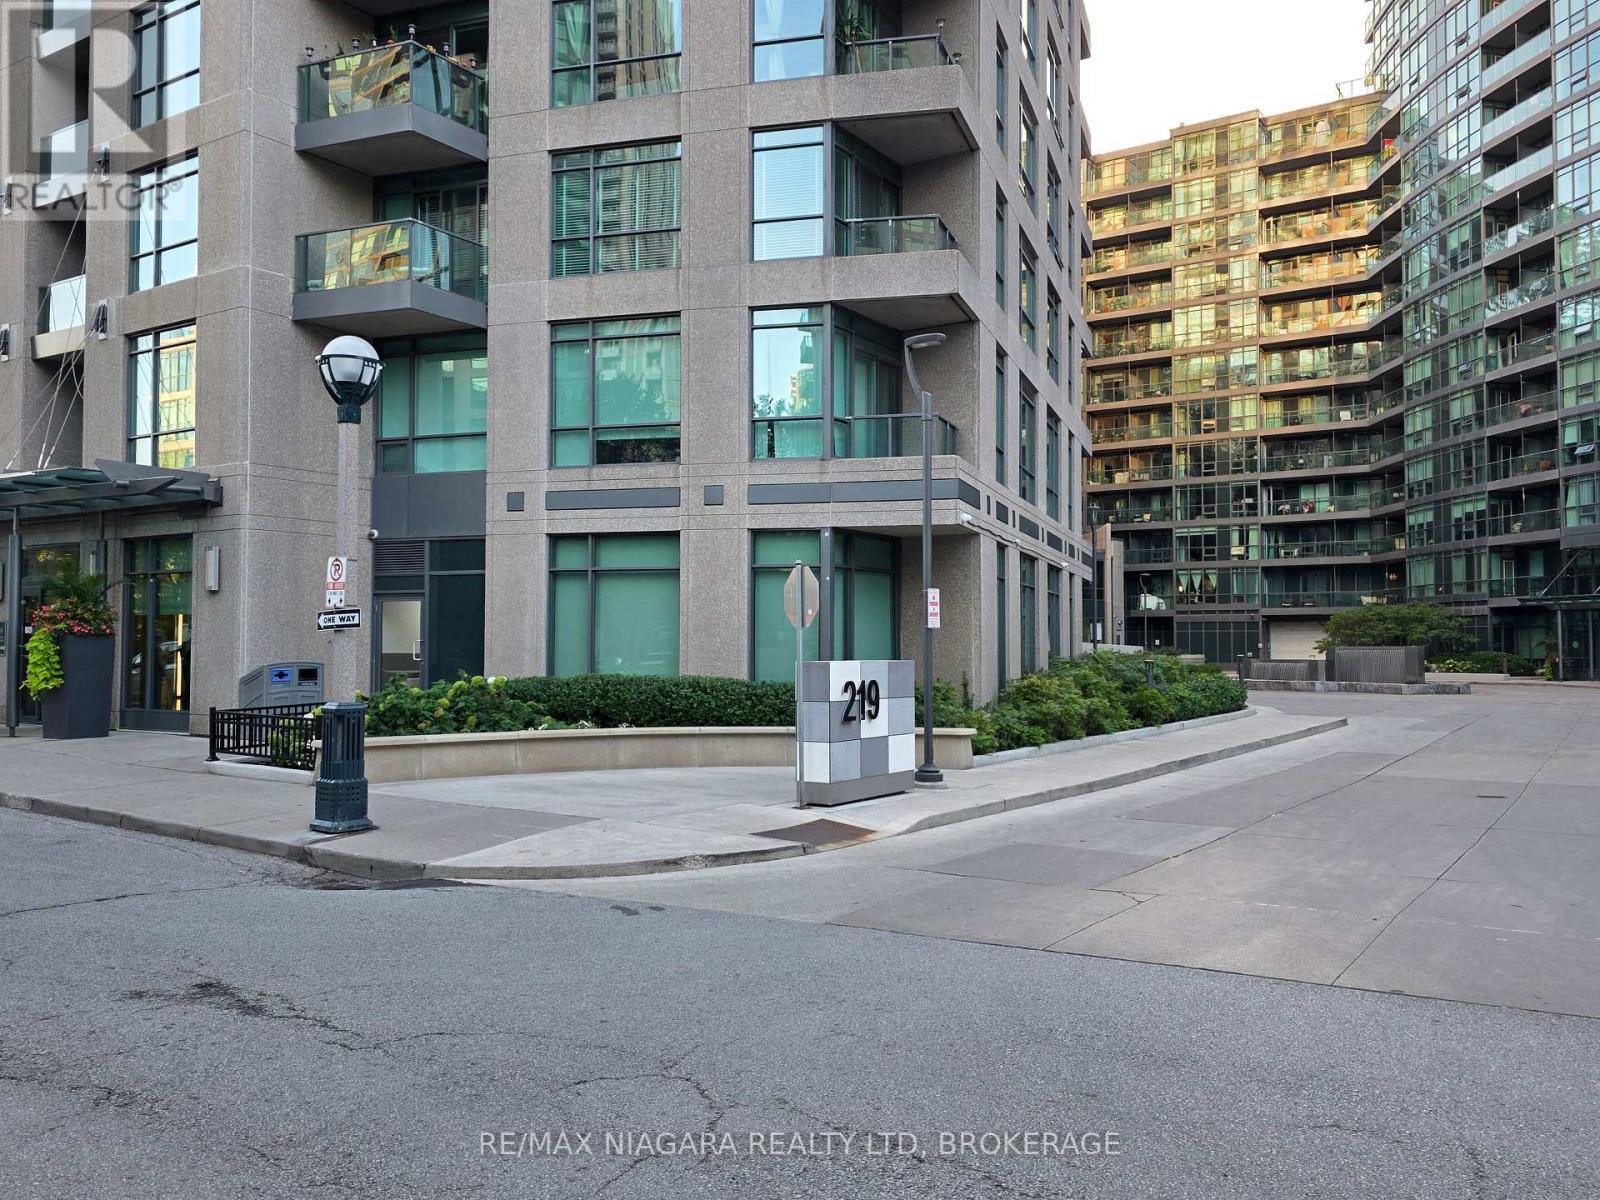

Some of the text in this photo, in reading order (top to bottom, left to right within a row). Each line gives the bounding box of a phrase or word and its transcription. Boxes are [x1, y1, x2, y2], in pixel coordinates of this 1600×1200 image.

[323, 615, 356, 624] ONE WAY
[842, 679, 880, 723] 219
